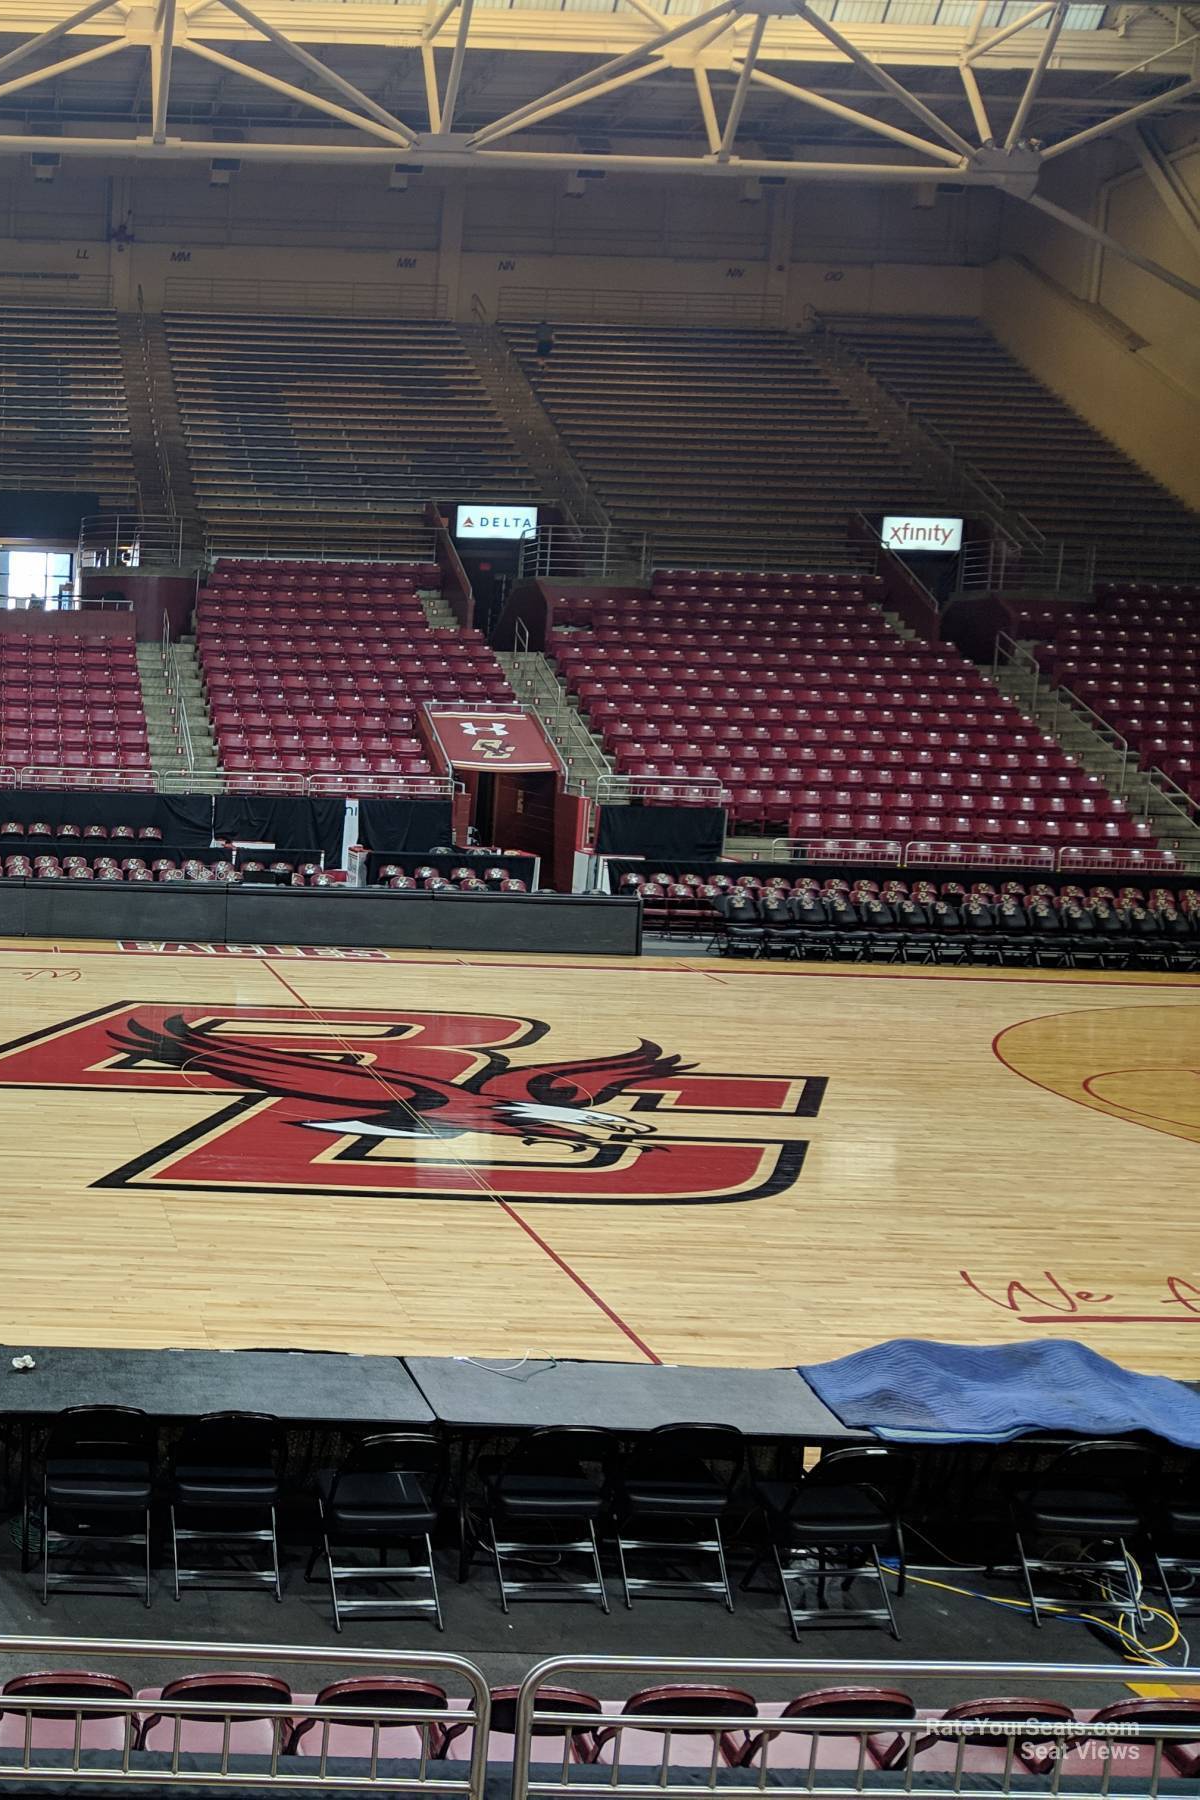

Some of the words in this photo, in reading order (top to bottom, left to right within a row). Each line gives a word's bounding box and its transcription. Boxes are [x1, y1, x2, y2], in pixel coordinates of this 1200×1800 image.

[76, 249, 89, 259] LL
[170, 251, 191, 262] MM
[480, 517, 532, 528] DELTA
[890, 522, 954, 546] xfinity
[116, 940, 391, 959] EAGLES
[959, 1269, 1115, 1313] We
